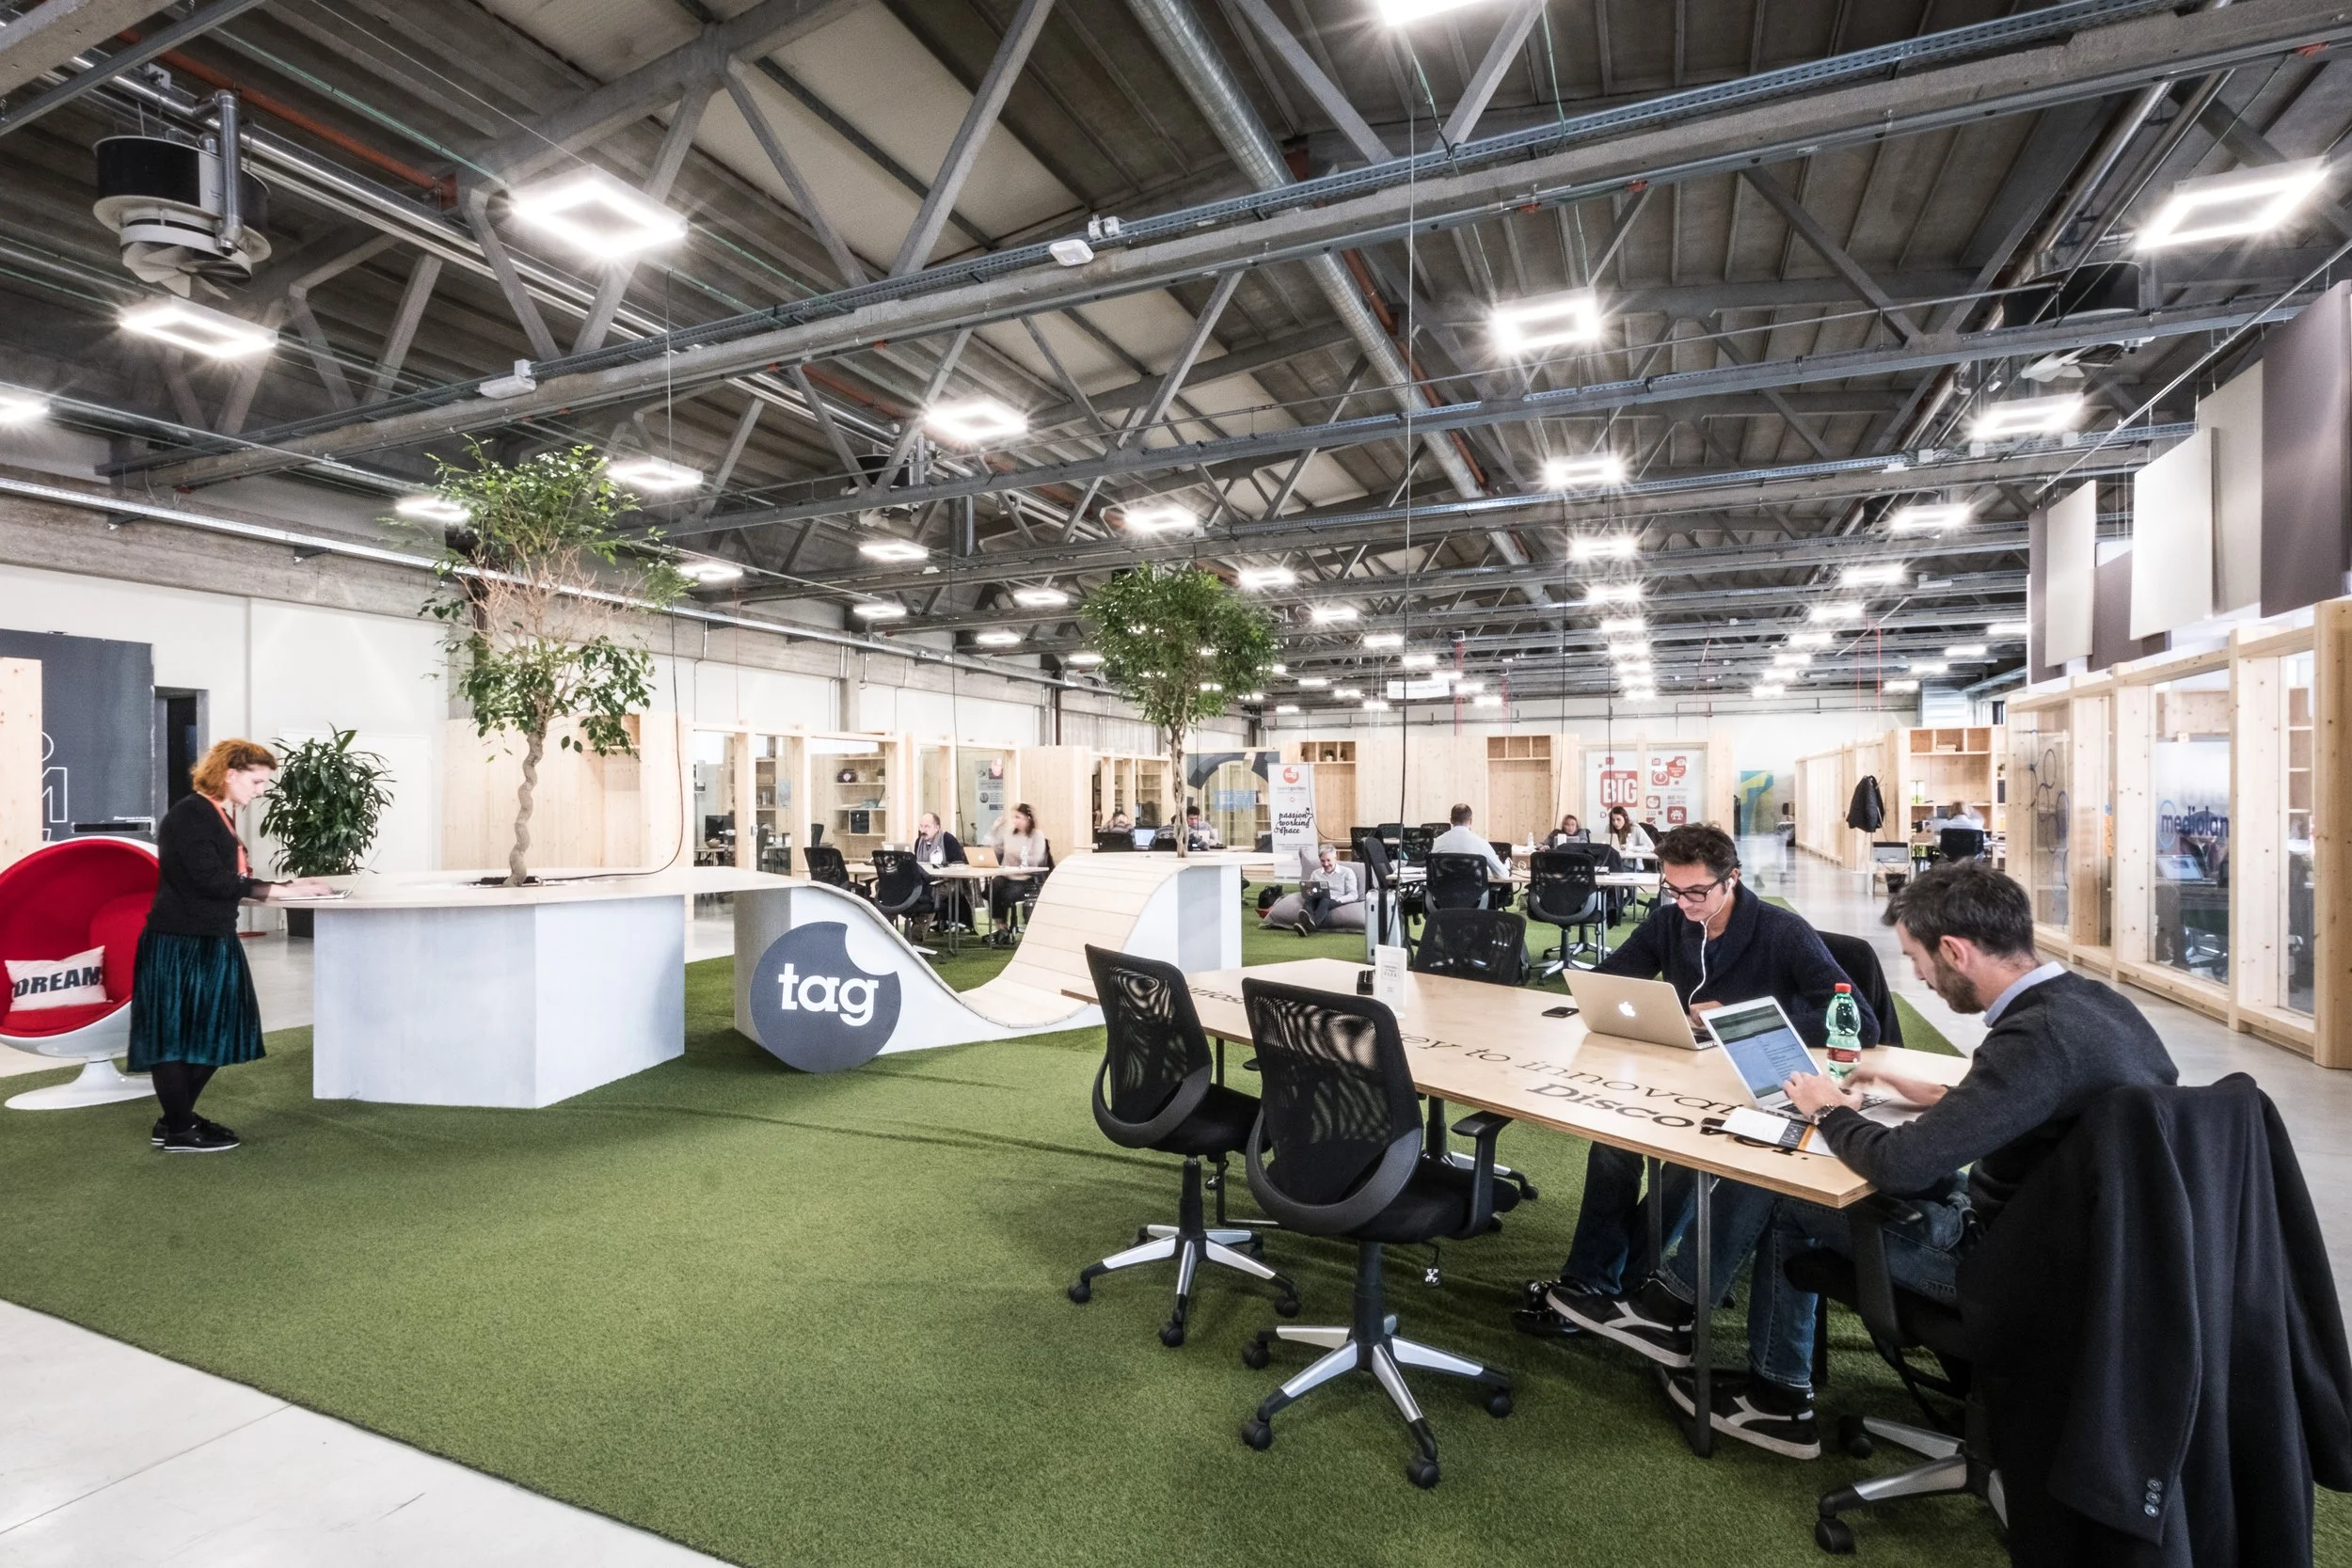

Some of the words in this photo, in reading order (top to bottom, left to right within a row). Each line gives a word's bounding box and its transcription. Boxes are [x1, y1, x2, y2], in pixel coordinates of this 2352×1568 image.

[1602, 778, 1638, 803] BIG
[1279, 810, 1307, 821] passion
[2161, 805, 2229, 837] mediolan
[13, 966, 102, 998] DREAM
[778, 962, 880, 1027] tag
[1465, 1049, 1511, 1062] to
[1514, 1060, 1744, 1115] innovat
